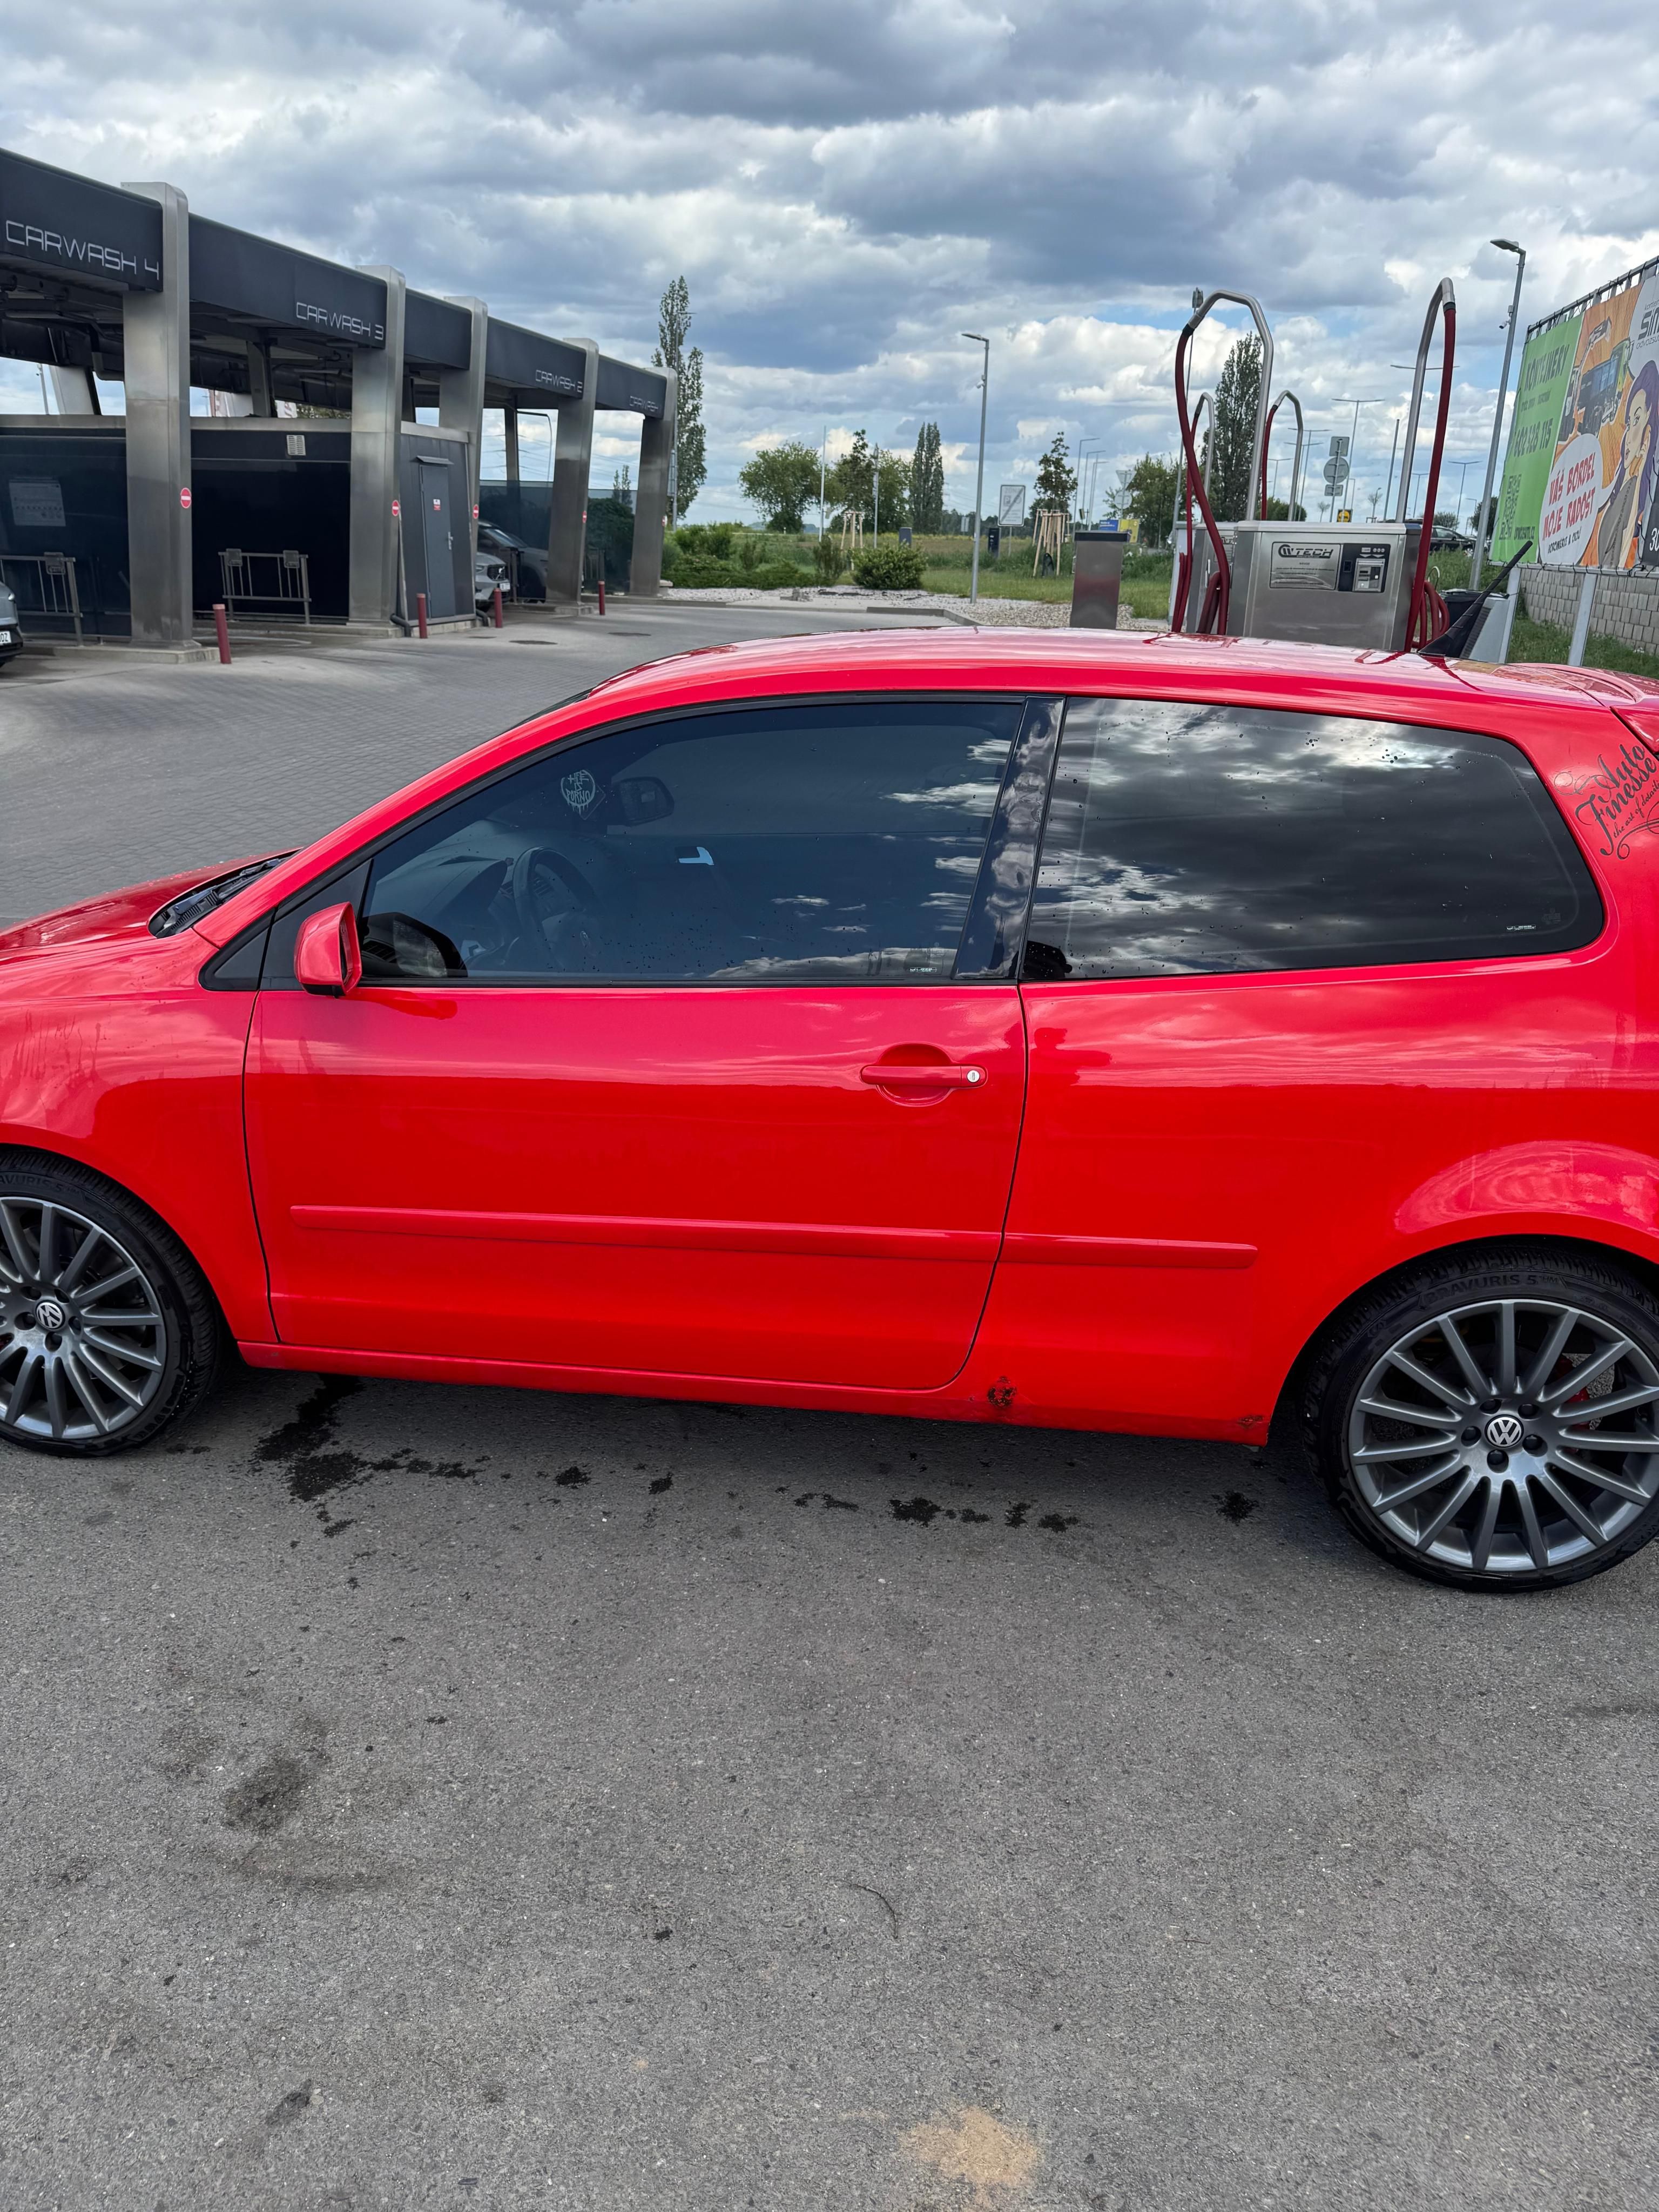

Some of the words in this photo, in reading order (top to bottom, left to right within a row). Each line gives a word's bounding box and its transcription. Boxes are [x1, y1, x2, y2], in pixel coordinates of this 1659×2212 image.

[6, 220, 138, 274] CARWASH
[144, 258, 159, 280] 4
[296, 302, 371, 337] CARWASH
[374, 324, 384, 340] 3
[536, 369, 575, 390] CARWASH
[577, 381, 583, 393] 2
[1524, 343, 1570, 392] KONTEJNERY
[629, 395, 658, 412] CARWASH
[1549, 467, 1564, 506] VÁŠ
[1567, 451, 1596, 496] BORDEL
[1542, 505, 1563, 541] MOJE
[1566, 487, 1595, 528] RADOST
[565, 788, 590, 805] PORNO
[1613, 822, 1625, 838] the
[1425, 1274, 1520, 1303] BRAVURIS
